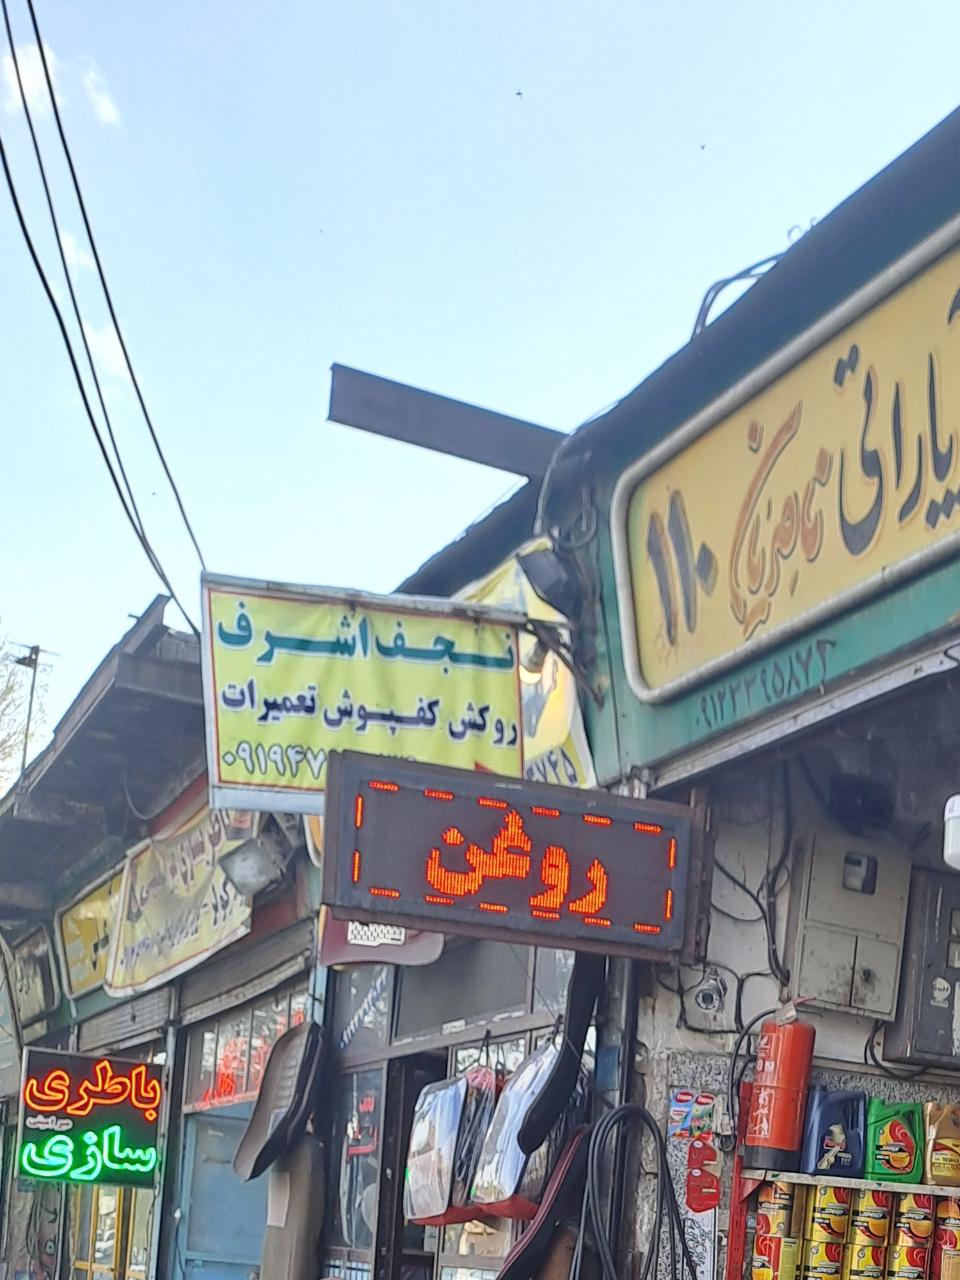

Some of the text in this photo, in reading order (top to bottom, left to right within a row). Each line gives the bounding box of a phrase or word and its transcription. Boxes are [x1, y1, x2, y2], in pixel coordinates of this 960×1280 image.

[647, 488, 718, 646] ۱۱۰
[217, 601, 514, 674] نجف اشرف
[221, 678, 518, 746] روکش کفپوش تعمیرات
[426, 808, 609, 914] روغن
[25, 1059, 161, 1121] باطری
[22, 1125, 158, 1181] سازی
